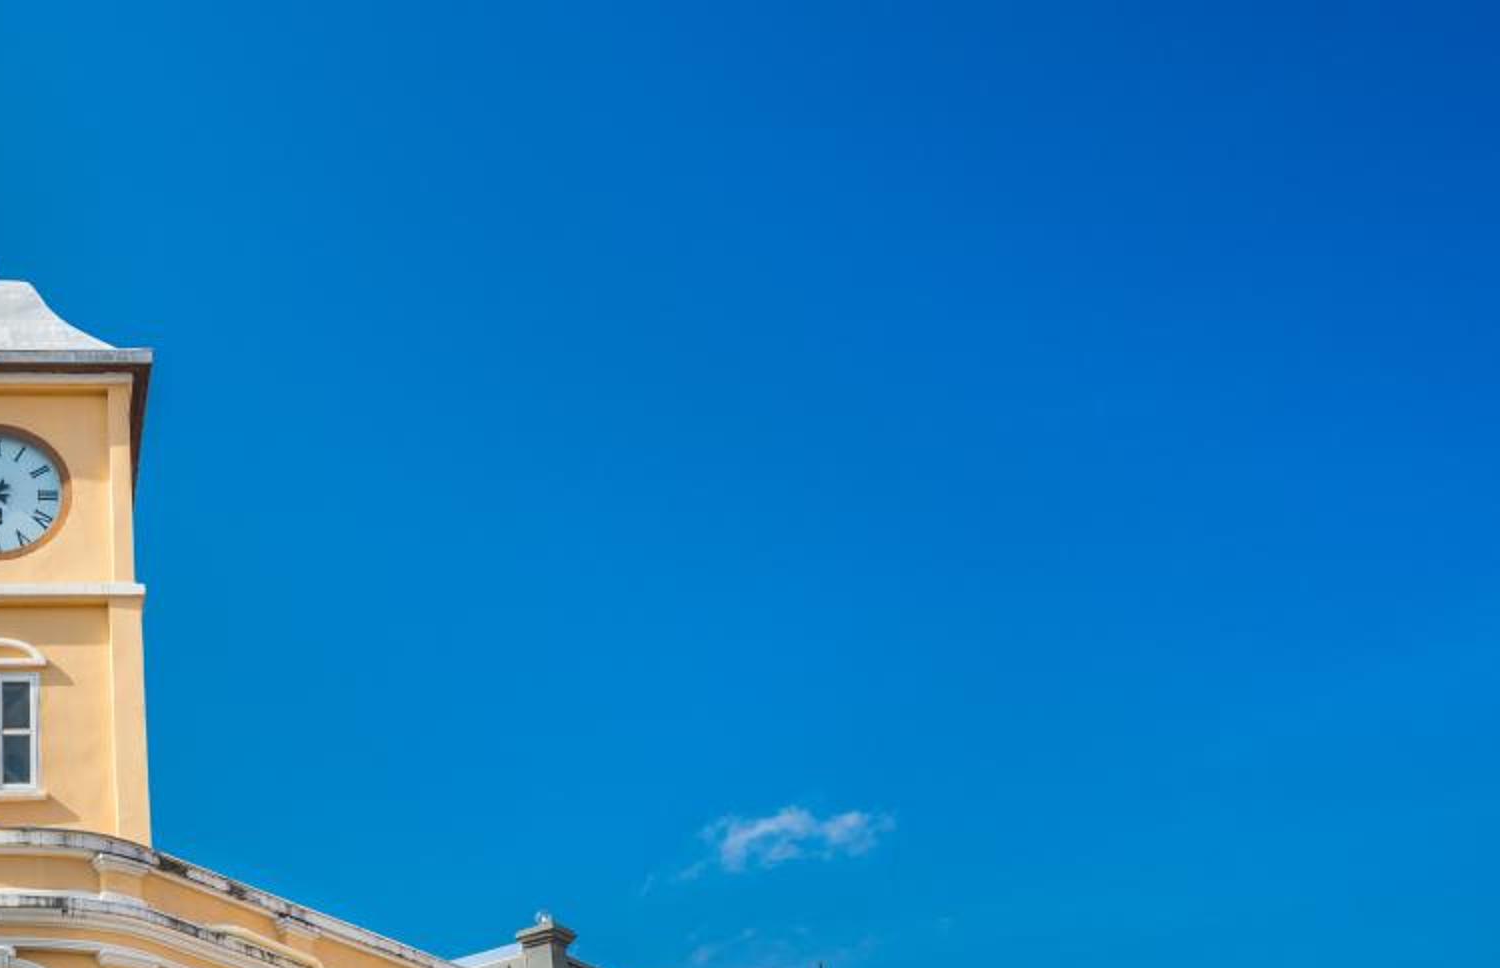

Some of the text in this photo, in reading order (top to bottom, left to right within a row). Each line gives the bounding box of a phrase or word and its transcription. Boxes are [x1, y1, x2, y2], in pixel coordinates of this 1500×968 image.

[29, 465, 51, 479] II
[31, 509, 53, 529] IV
[16, 529, 31, 546] V
